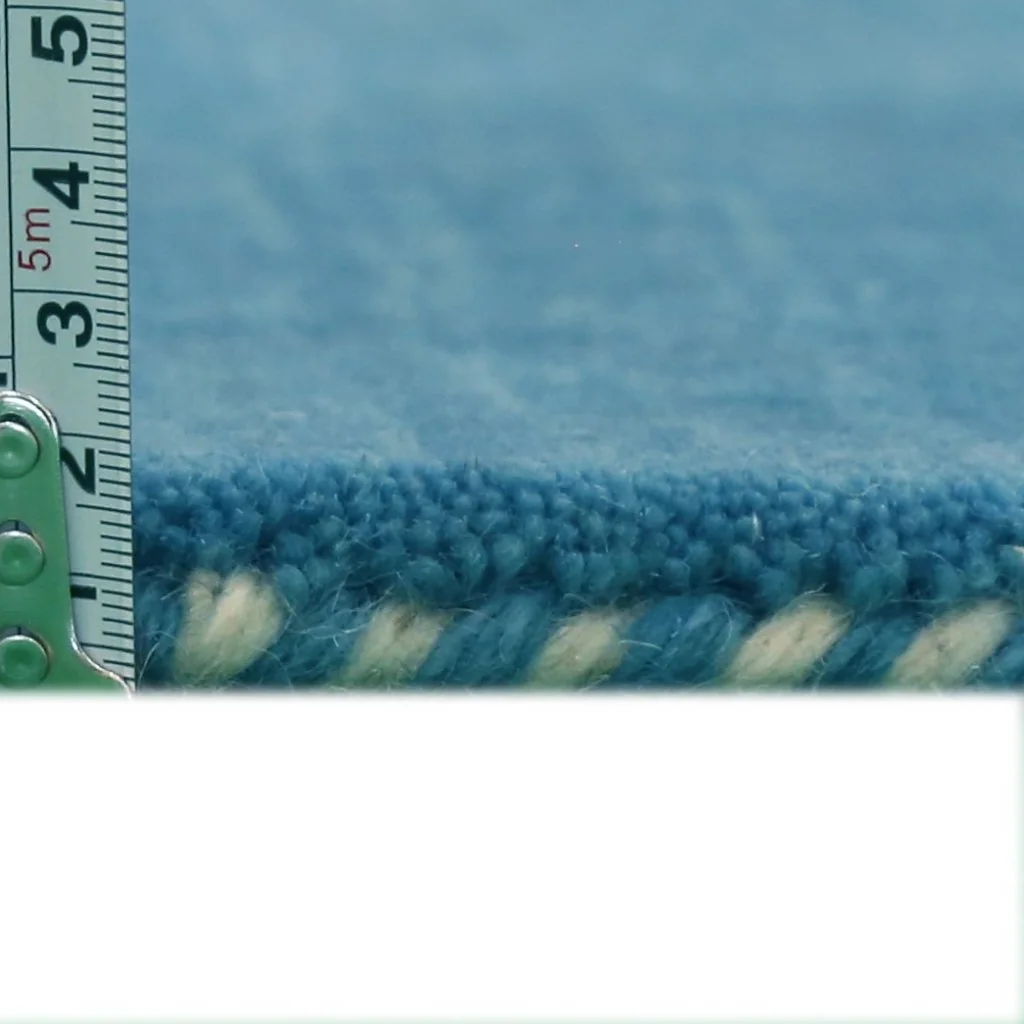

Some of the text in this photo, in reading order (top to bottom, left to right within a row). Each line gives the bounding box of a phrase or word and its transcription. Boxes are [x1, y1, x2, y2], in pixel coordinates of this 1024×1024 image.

[31, 14, 88, 66] 5
[32, 162, 89, 210] 4
[17, 208, 51, 272] 5m
[36, 301, 93, 348] 3
